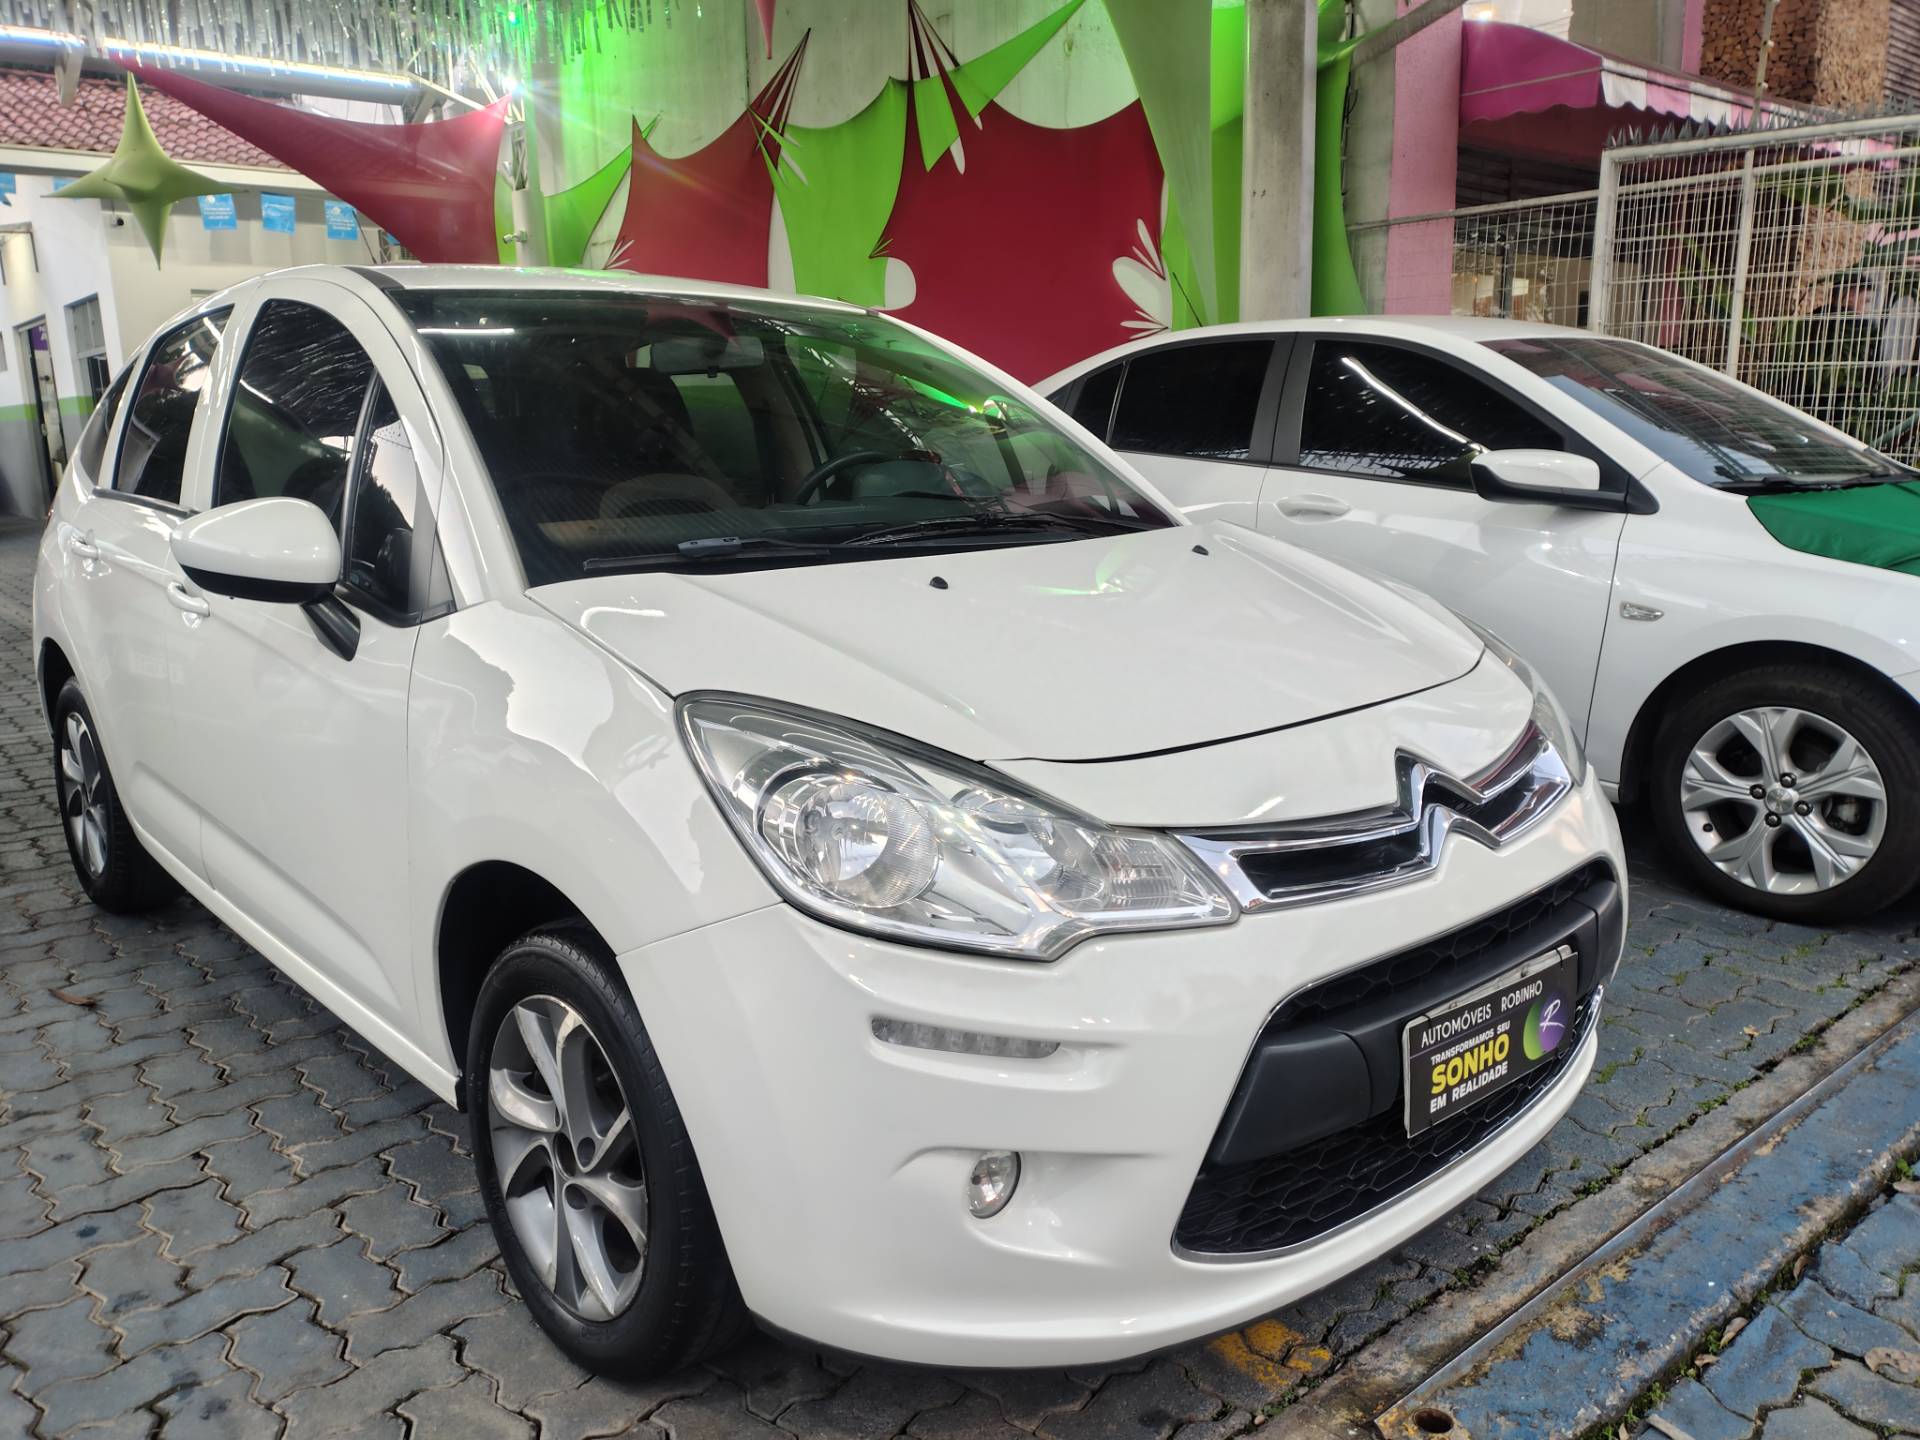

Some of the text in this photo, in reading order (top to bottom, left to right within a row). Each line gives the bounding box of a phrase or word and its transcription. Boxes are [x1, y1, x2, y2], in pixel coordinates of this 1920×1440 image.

[1421, 980, 1543, 1048] AUTOMÓVEIS ROBINHO
[1431, 1020, 1511, 1065] TRANSFORMAMOS SEU
[1430, 1061, 1509, 1114] EM REALIDADE
[1431, 1033, 1510, 1094] SONHO
